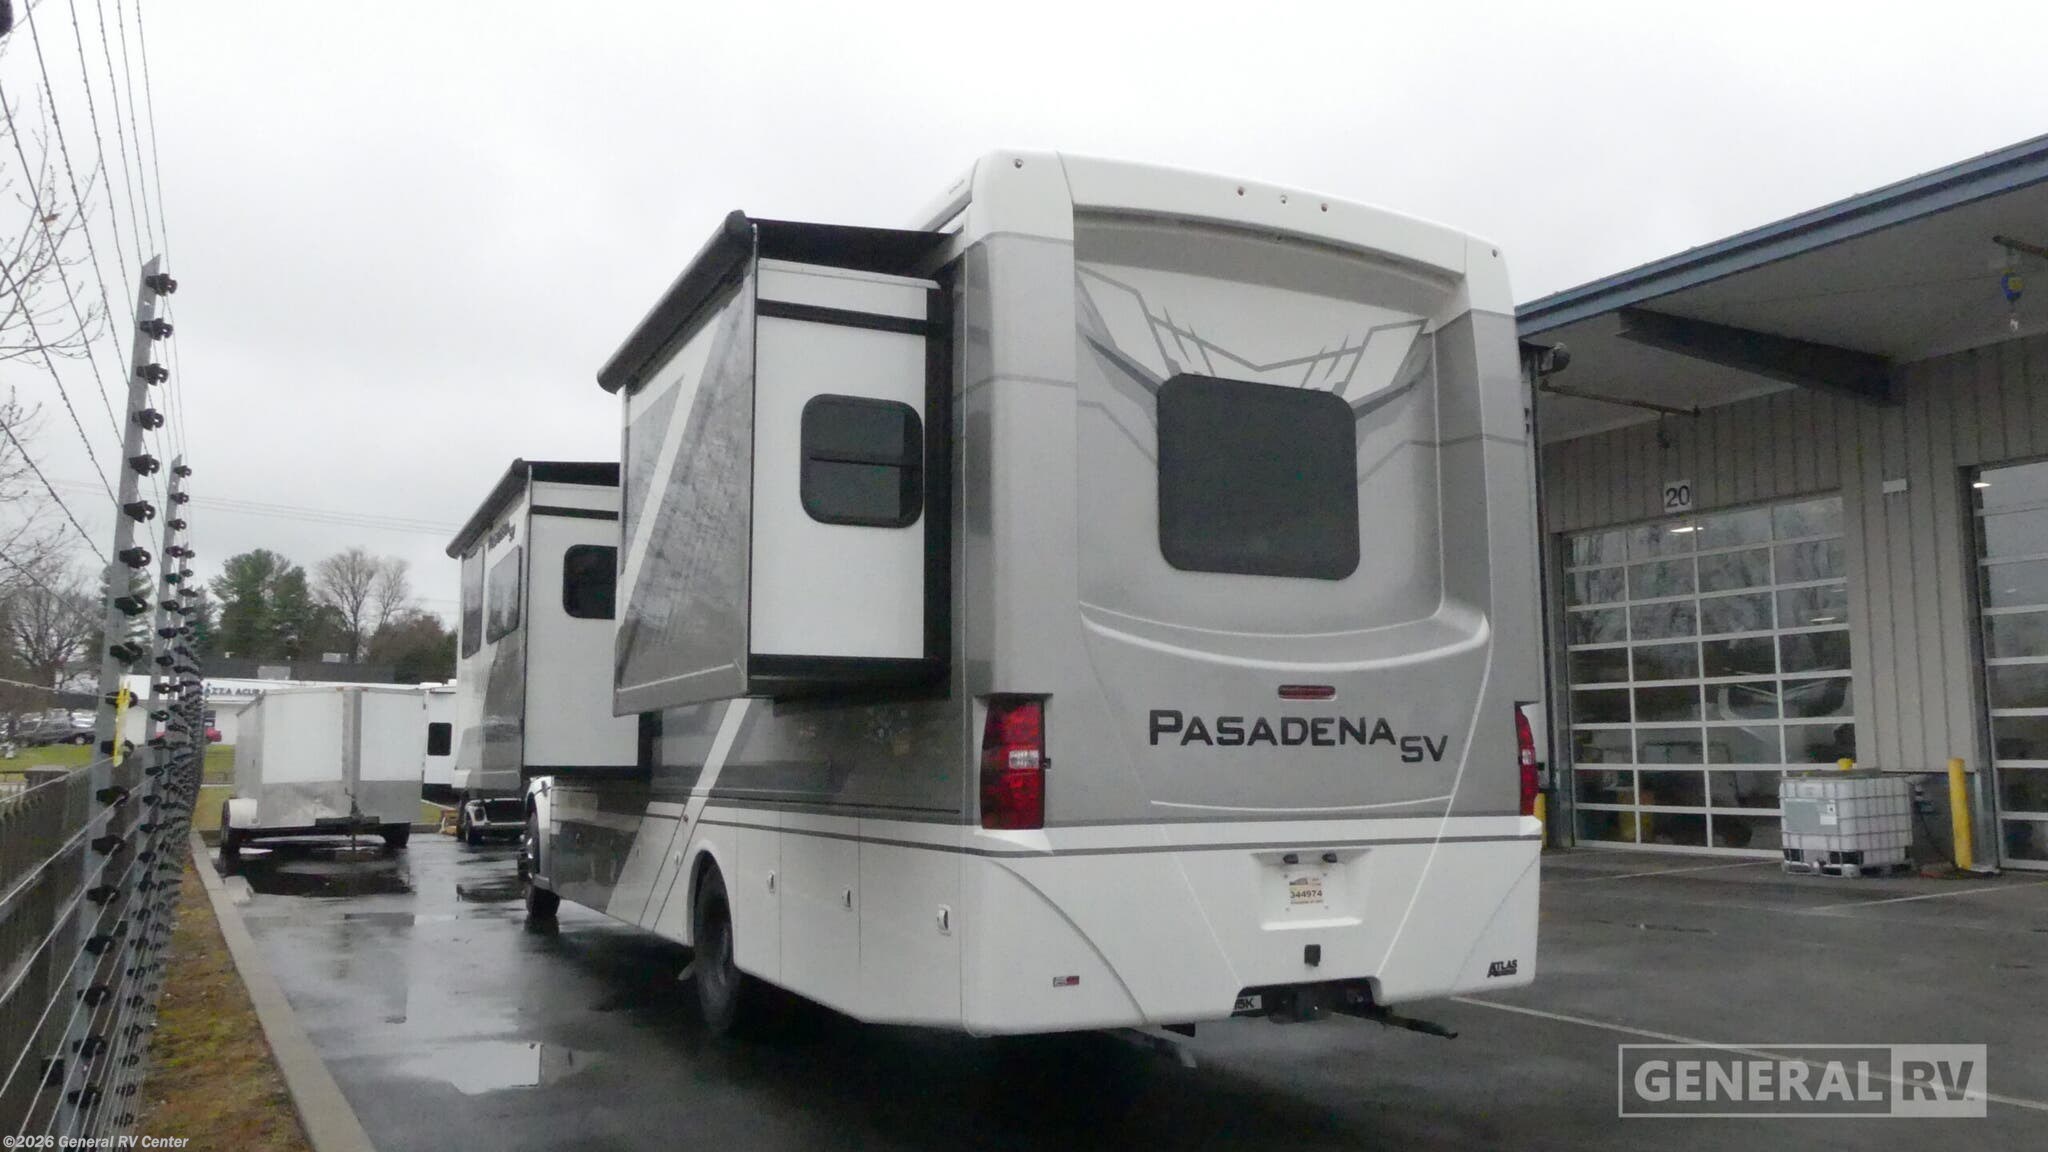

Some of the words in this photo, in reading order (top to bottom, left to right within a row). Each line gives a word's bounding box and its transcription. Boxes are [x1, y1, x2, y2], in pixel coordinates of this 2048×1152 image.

[1665, 485, 1690, 508] 20
[1149, 709, 1397, 747] PASADENA
[1400, 735, 1449, 763] SV
[1290, 889, 1323, 899] 344974
[1487, 959, 1518, 978] ATLAS
